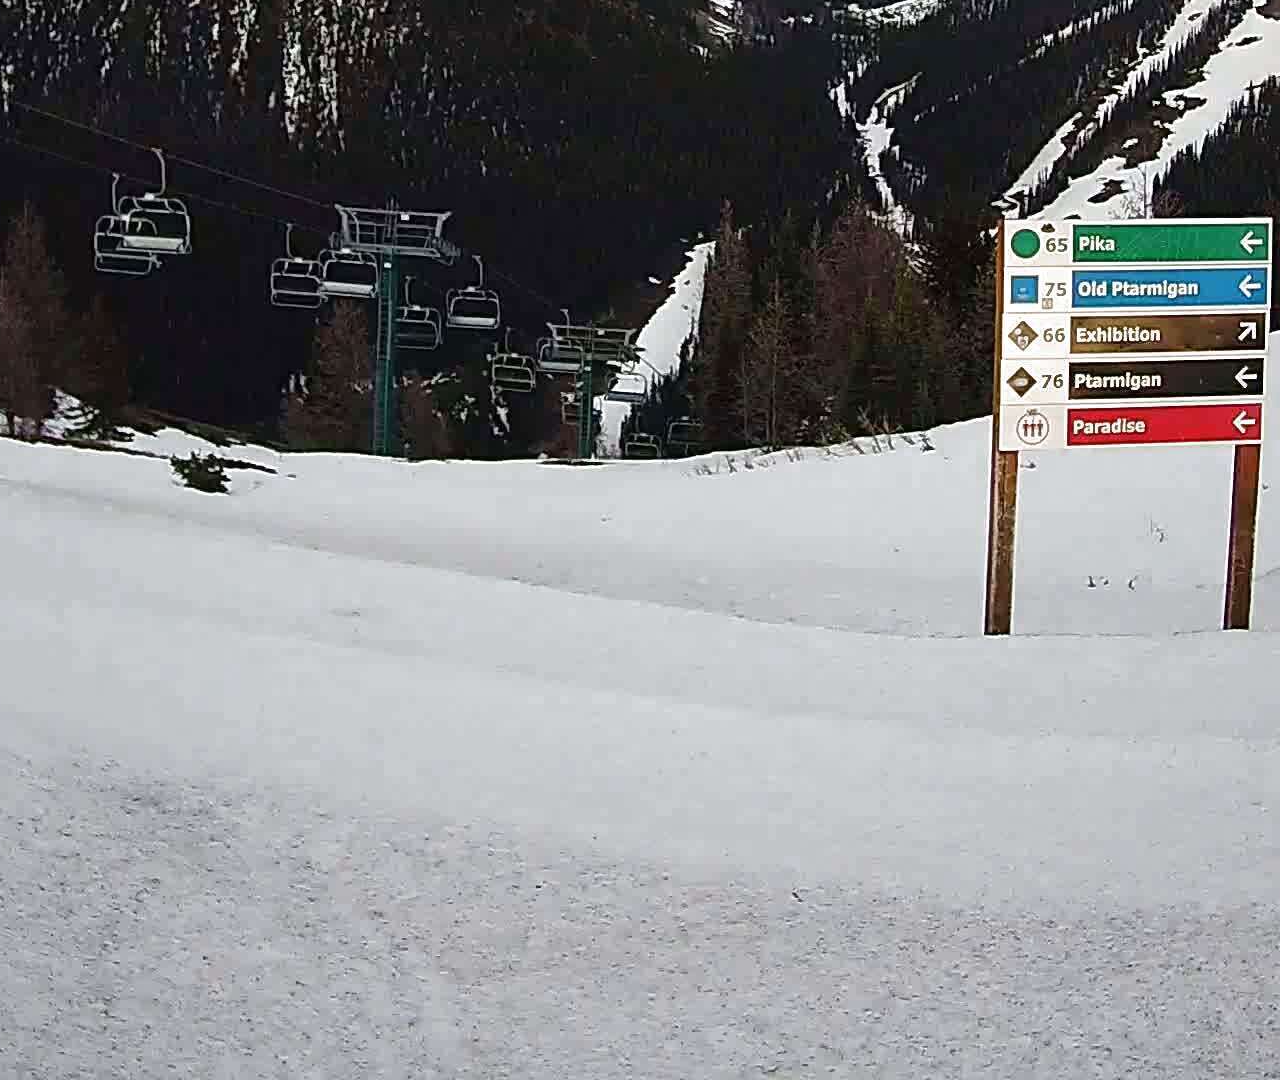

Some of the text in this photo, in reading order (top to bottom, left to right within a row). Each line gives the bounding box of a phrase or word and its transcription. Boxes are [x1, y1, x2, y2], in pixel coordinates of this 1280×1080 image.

[1045, 236, 1116, 253] 65 Pika
[1044, 279, 1199, 299] 75 Old Ptarmigan
[1043, 326, 1161, 343] 66 Exhibition
[1041, 371, 1162, 392] 76 Ptarmigan
[1072, 417, 1146, 436] Paradise
